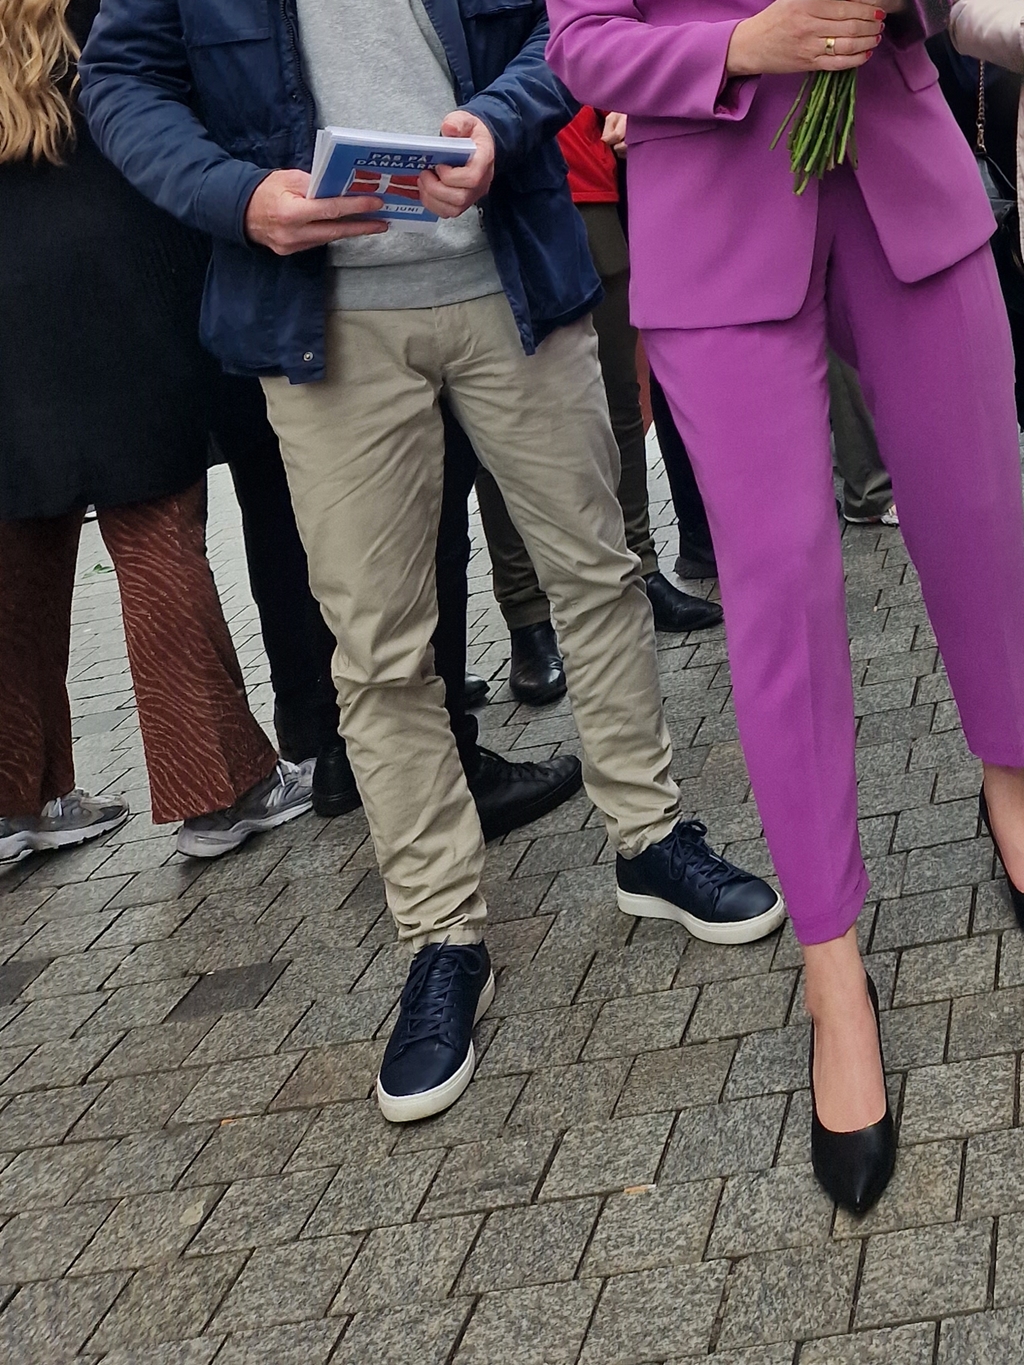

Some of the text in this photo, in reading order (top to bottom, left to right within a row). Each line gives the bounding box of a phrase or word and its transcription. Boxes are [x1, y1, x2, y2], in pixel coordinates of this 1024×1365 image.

[371, 153, 427, 162] PAS PÅ
[356, 159, 436, 169] DANMARK
[395, 205, 419, 213] JUNI
